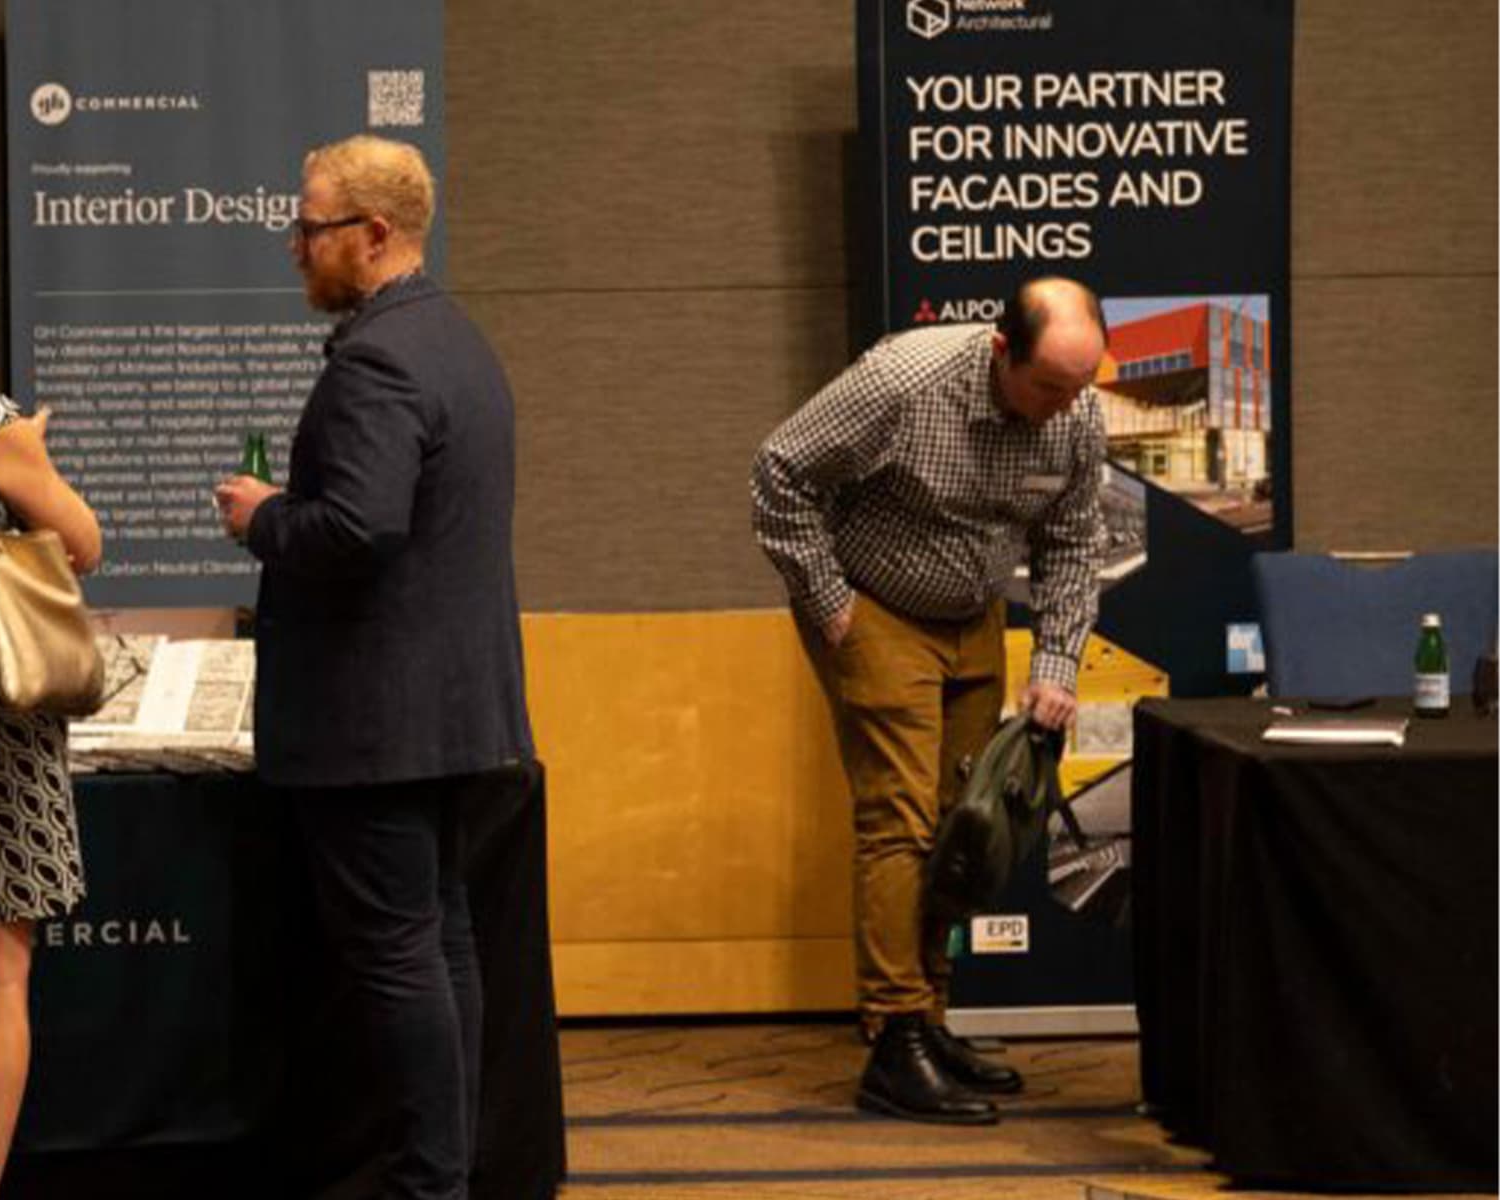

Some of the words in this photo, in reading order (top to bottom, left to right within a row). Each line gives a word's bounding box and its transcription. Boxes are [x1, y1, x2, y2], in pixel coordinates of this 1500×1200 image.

[956, 14, 1053, 30] Architectural
[76, 95, 200, 111] COMMERCIAL
[906, 74, 1023, 112] YOUR
[1034, 71, 1226, 108] PARTNER
[910, 126, 994, 161] FOR
[1004, 119, 1249, 159] INNOVATIVE
[33, 188, 176, 226] Interior
[911, 173, 1099, 211] FACADES
[1109, 170, 1203, 207] AND
[911, 223, 1092, 262] CEILINGS
[940, 299, 1004, 321] ALPO
[987, 920, 1024, 937] EPD
